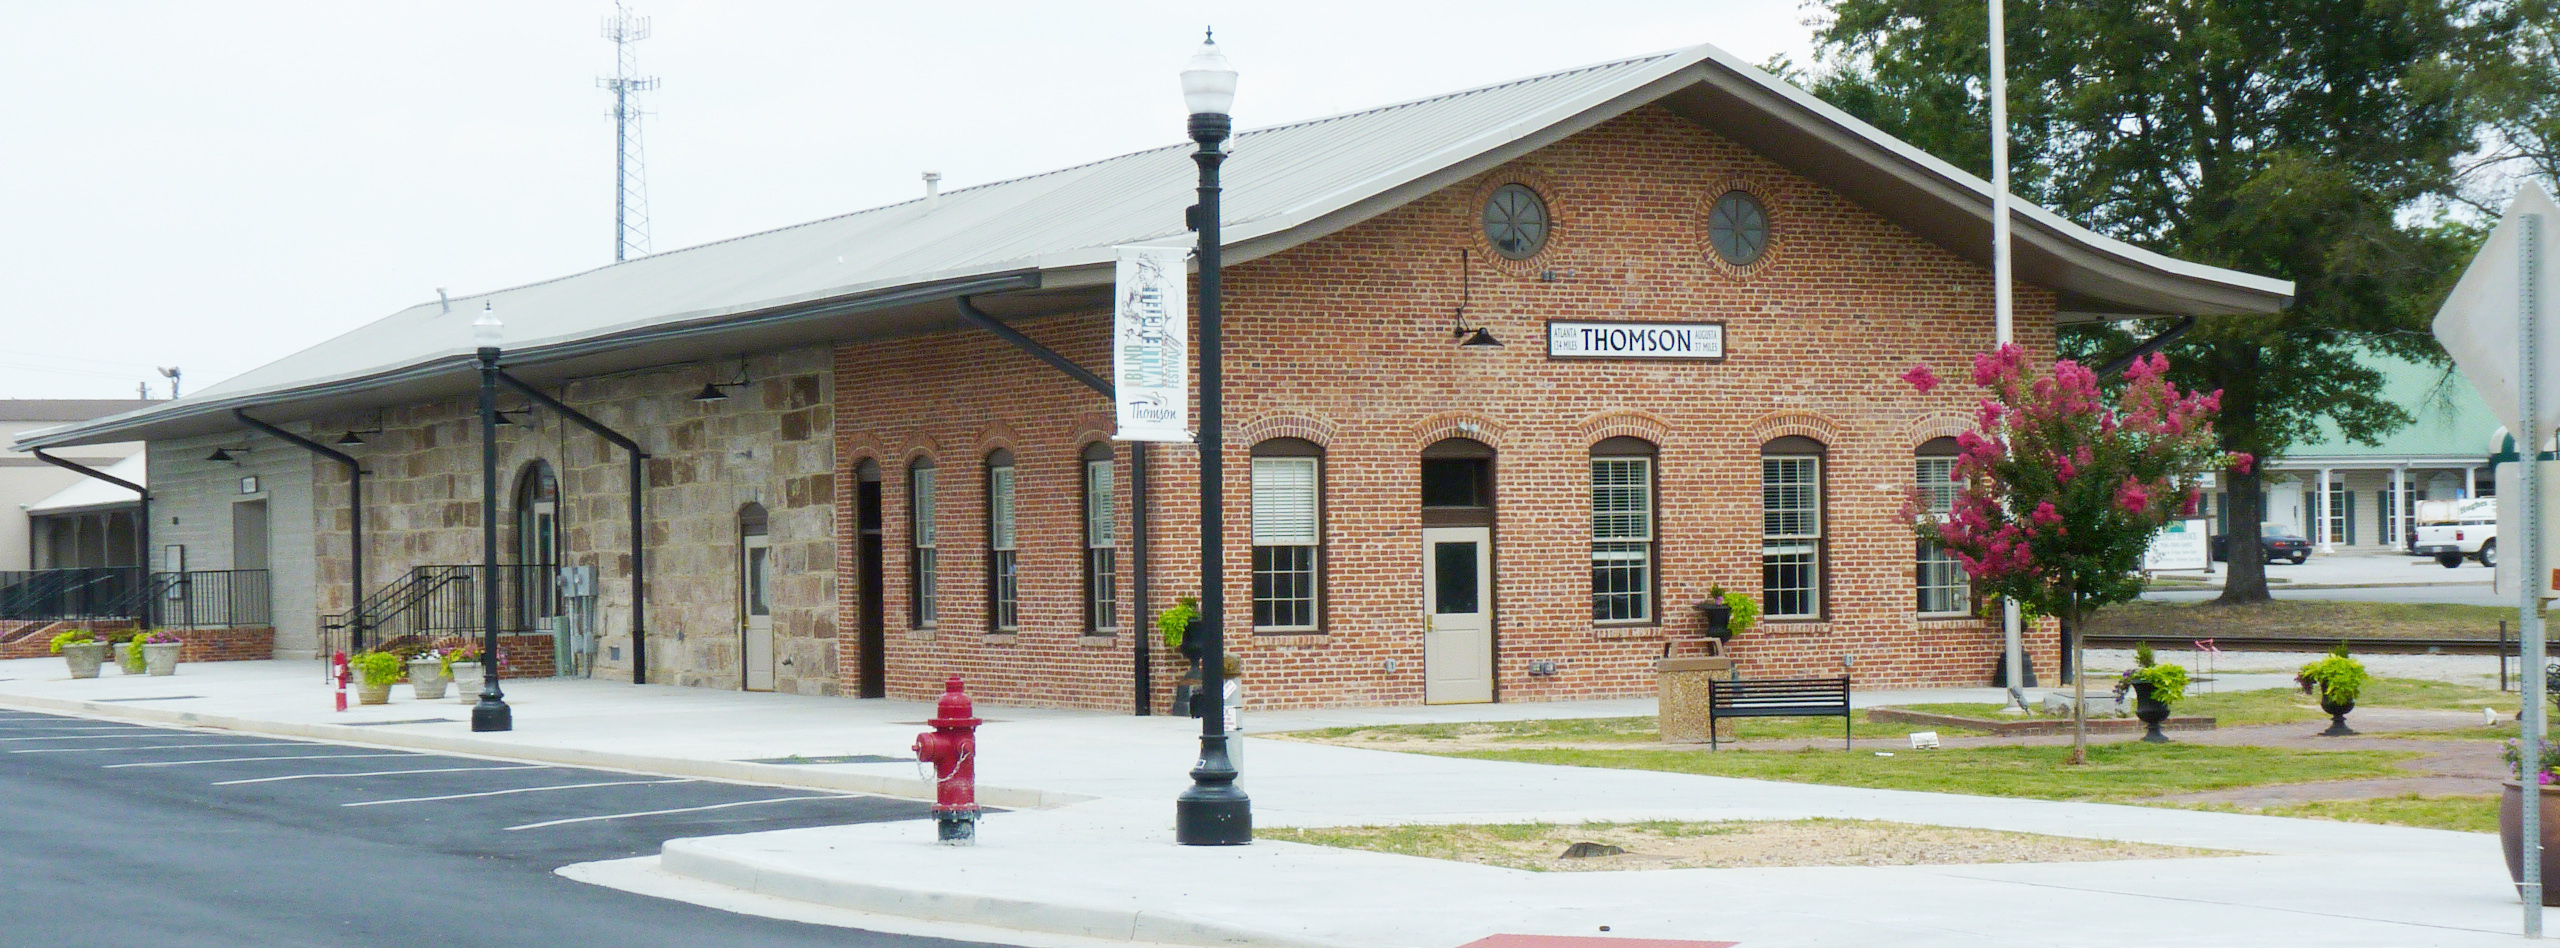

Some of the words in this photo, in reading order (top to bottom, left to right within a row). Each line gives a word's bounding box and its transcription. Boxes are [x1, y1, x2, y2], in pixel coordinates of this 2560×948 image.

[1554, 327, 1577, 338] ATLANTA
[1580, 328, 1691, 352] THOMSON
[1695, 329, 1717, 340] AUGUSTA
[1563, 340, 1578, 351] MILES
[1695, 342, 1701, 352] 37
[1702, 342, 1718, 352] MILES
[1124, 345, 1142, 380] BLIND
[1142, 339, 1162, 388] WILLIE
[1167, 350, 1179, 389] FESTIVAL
[1129, 401, 1177, 420] Thomson
